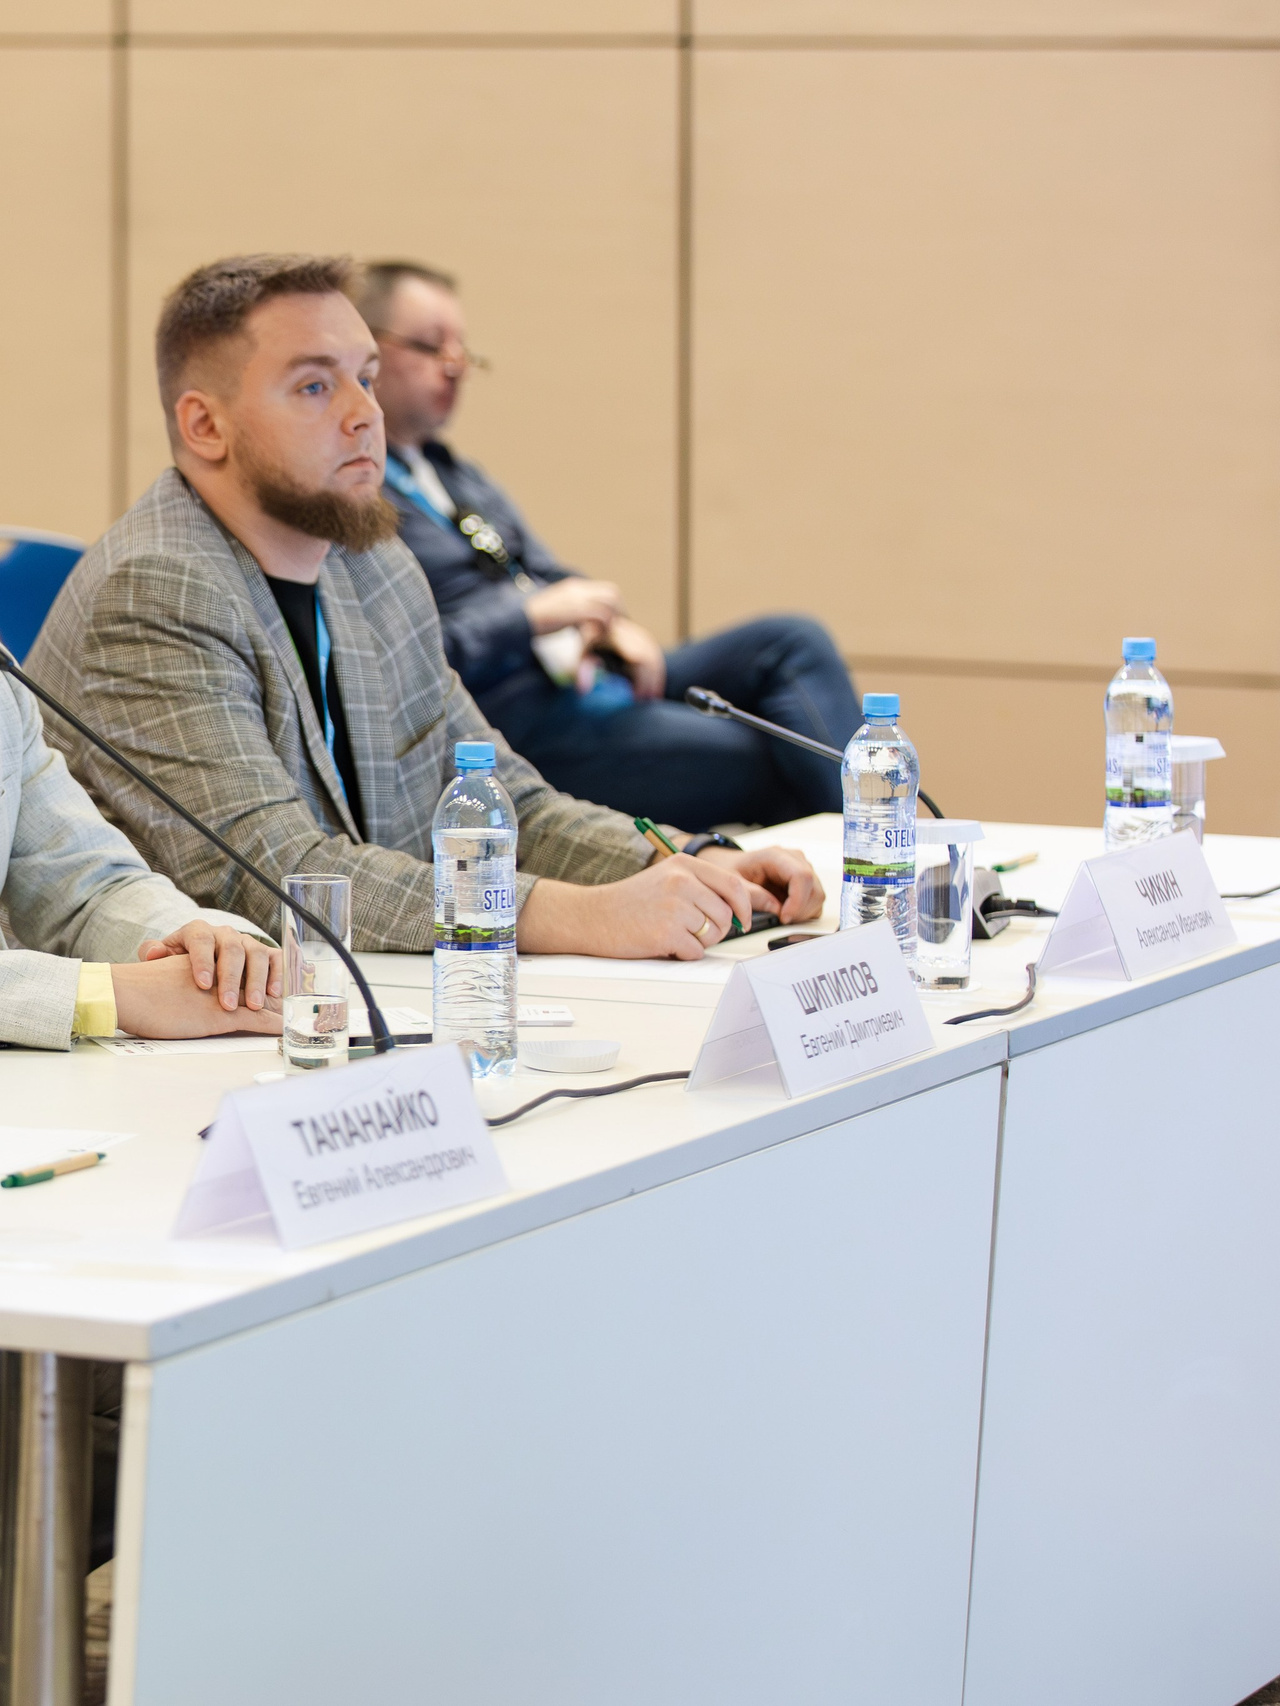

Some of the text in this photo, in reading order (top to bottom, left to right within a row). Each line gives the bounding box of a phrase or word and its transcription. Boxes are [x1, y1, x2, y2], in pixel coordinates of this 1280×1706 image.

[1135, 869, 1183, 906] ЧИКИН
[1136, 910, 1213, 949] Александр Иванович
[791, 961, 878, 1015] ШИПИЛОВ
[800, 1010, 905, 1059] Евгений Дмитриевич
[291, 1088, 439, 1156] ТАНАНАЙКО
[292, 1145, 477, 1210] Евгений Александрович
